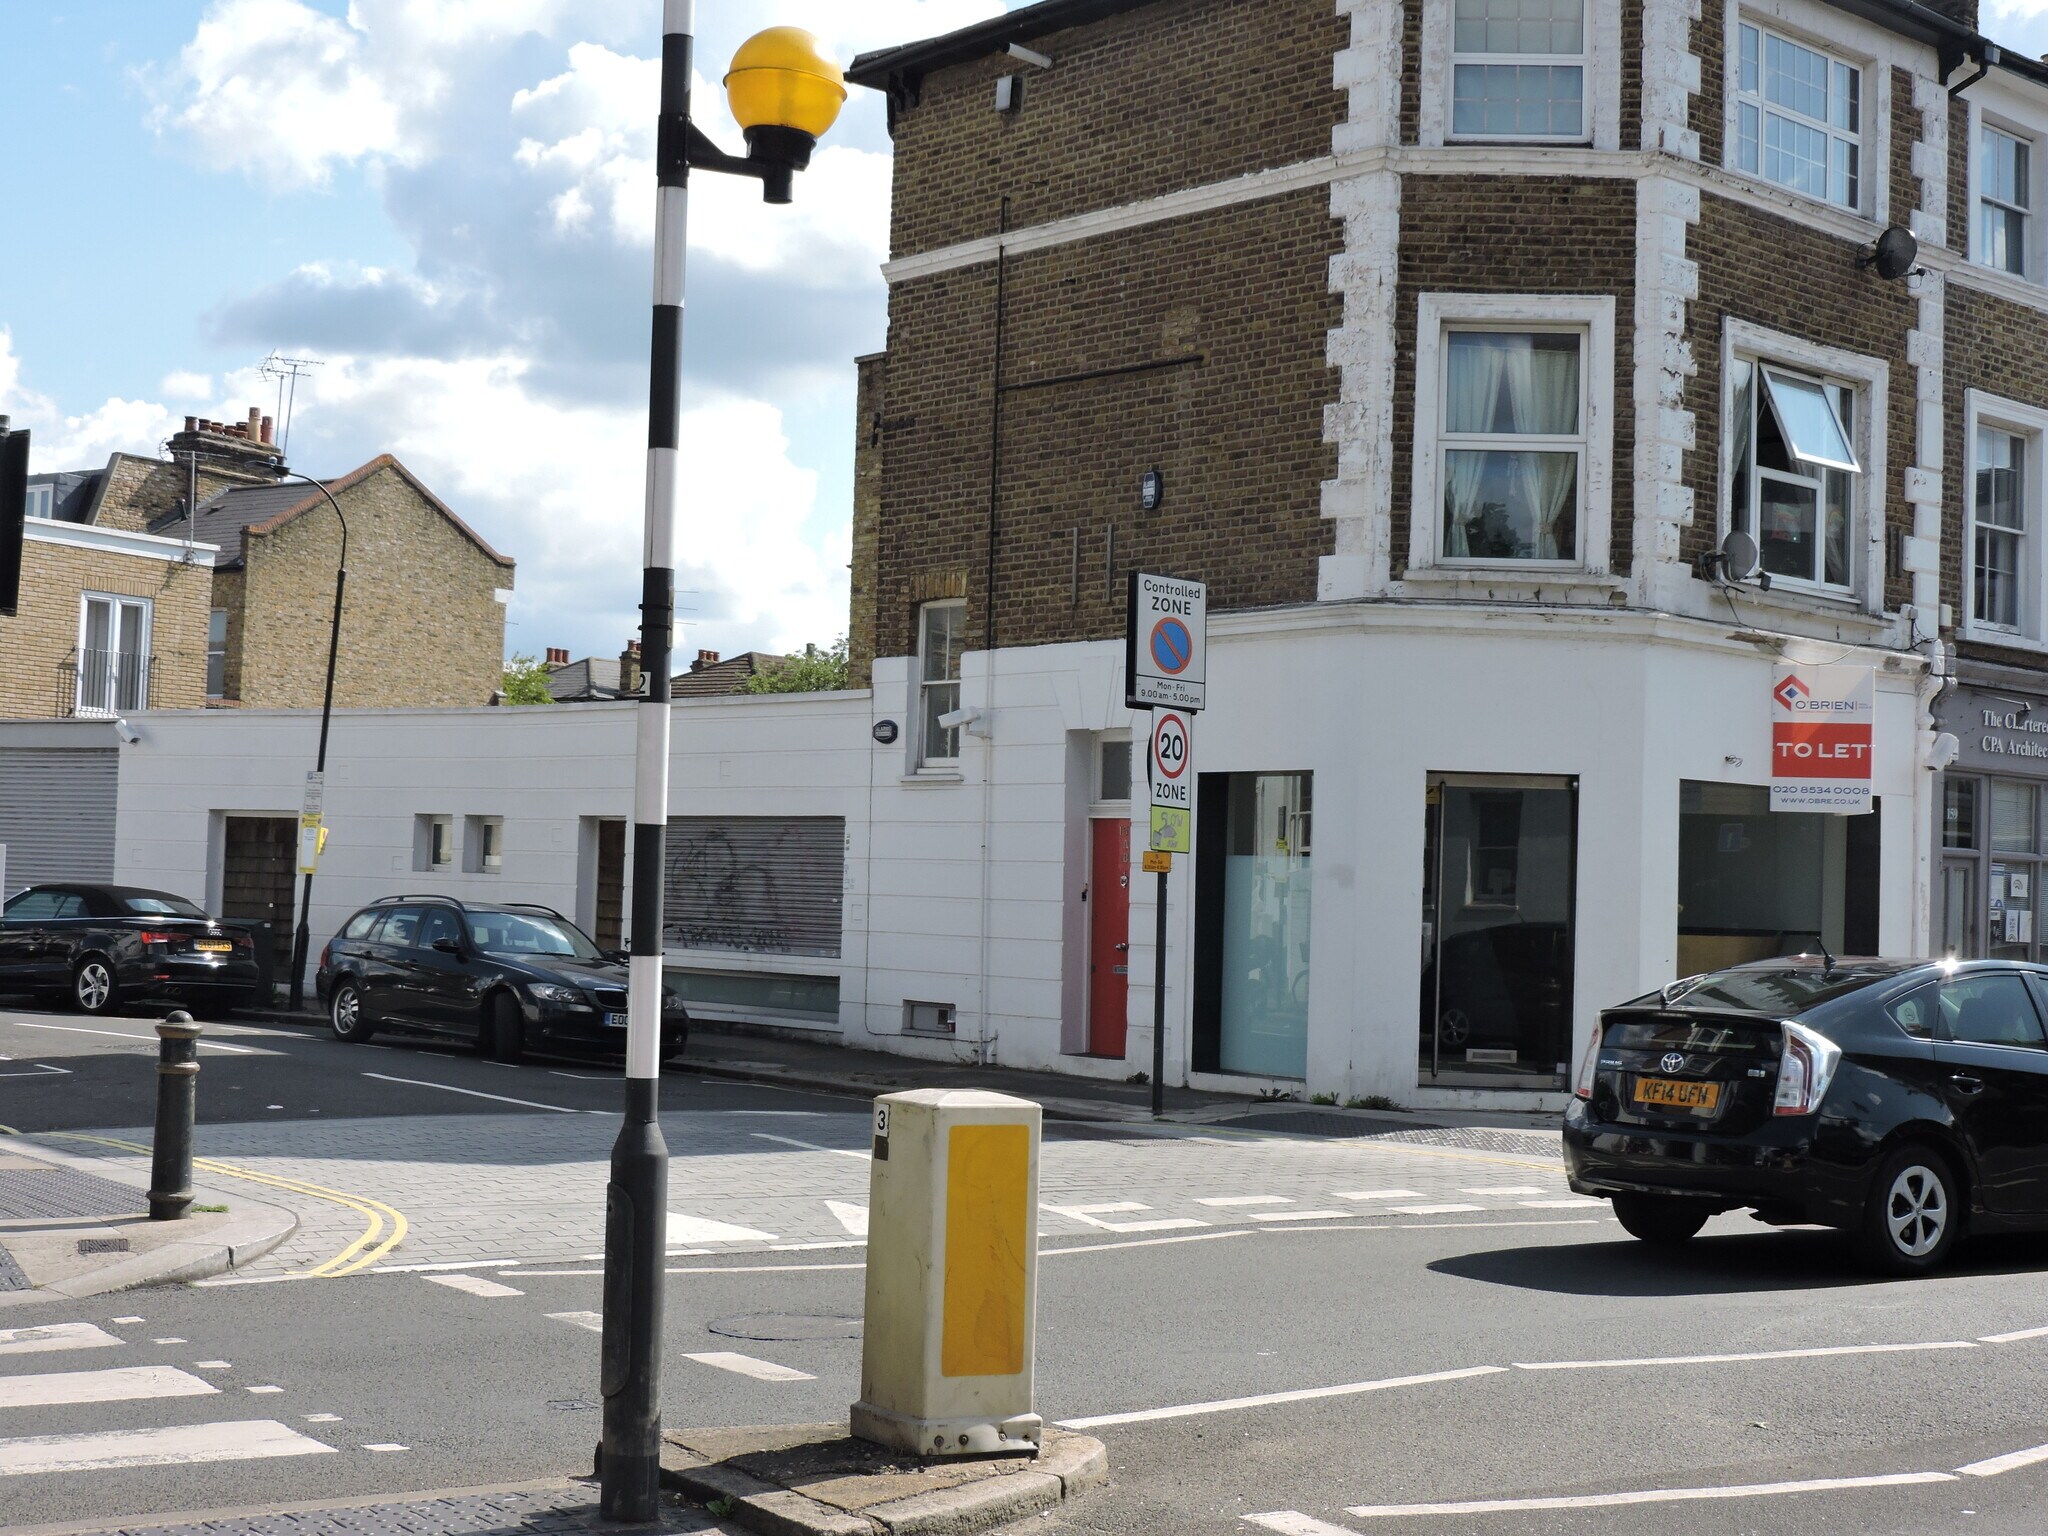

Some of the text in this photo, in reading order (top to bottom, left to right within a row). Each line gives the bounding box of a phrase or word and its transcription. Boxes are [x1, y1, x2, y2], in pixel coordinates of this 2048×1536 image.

[1144, 579, 1201, 599] Controlled
[1152, 596, 1191, 616] ZONE
[639, 673, 646, 695] 2
[1795, 700, 1854, 710] O'BRIEN
[1982, 709, 2002, 727] The
[1160, 732, 1184, 761] 20
[1776, 742, 1868, 759] TO LET
[1982, 735, 2004, 753] CPA
[1156, 782, 1186, 801] ZONE
[1772, 785, 1870, 795] 020 8534 0008
[1781, 797, 1861, 805] WWW.OBRE.CO.UK
[1643, 1081, 1709, 1105] KF14 UFN
[877, 1109, 886, 1131] 3
